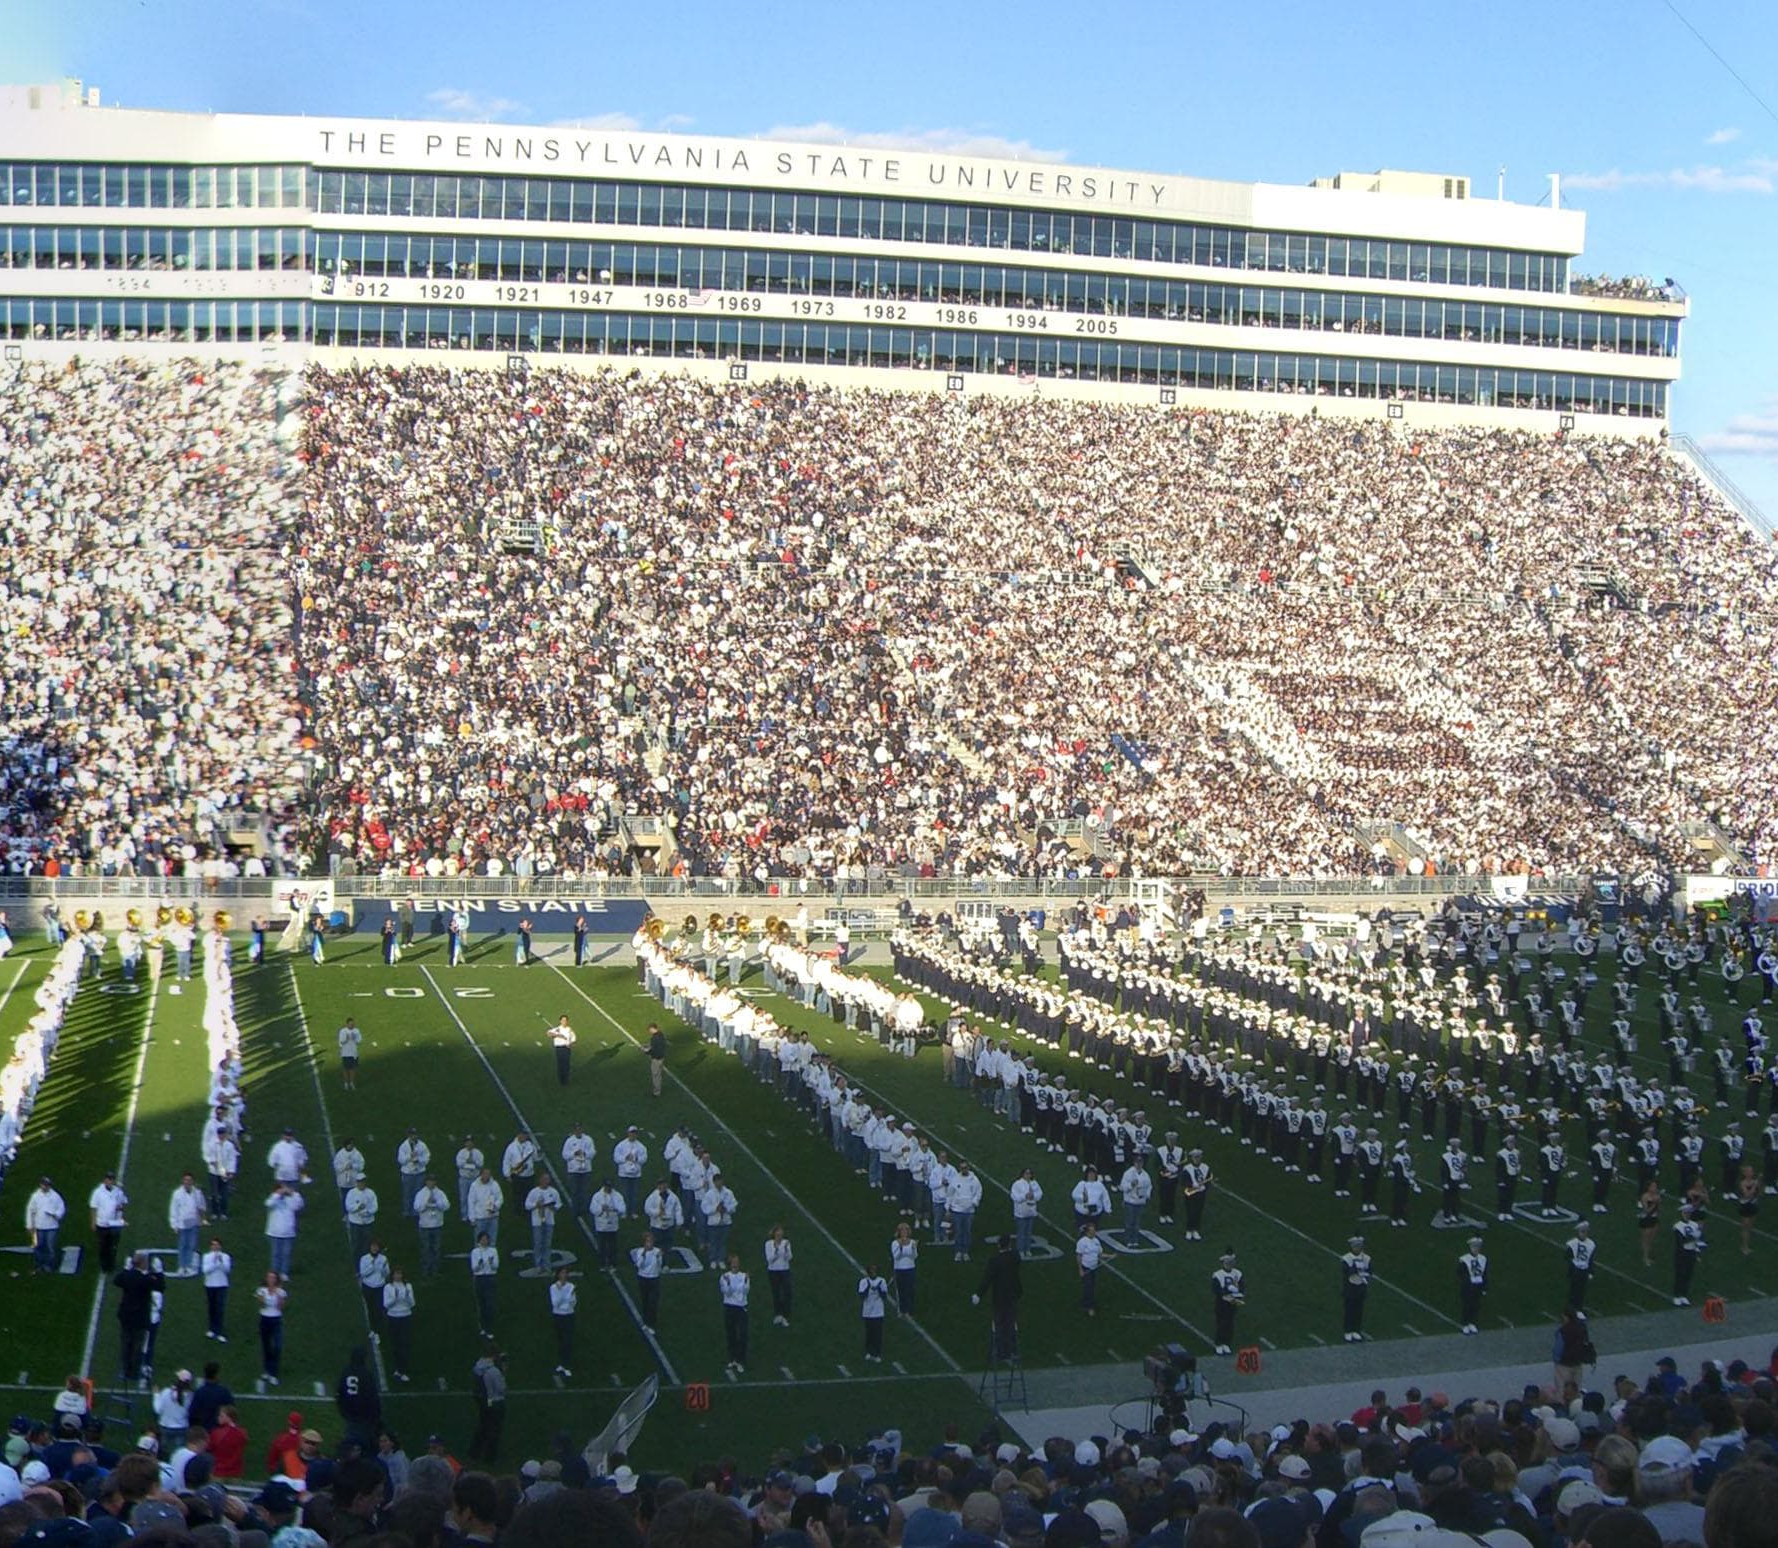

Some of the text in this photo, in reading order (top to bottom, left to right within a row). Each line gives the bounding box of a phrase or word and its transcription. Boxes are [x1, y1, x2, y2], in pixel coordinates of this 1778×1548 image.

[320, 131, 1166, 205] THE PENNSYLVANIA STATE UNIVERSITY
[419, 284, 465, 300] 1920
[496, 287, 540, 302] 1921
[569, 290, 613, 305] 1947
[644, 293, 688, 308] 1968
[718, 296, 762, 312] 1969
[791, 300, 835, 316] 1973
[864, 305, 907, 321] 1982
[935, 309, 978, 325] 1986
[1006, 313, 1048, 330] 1994
[1076, 318, 1118, 335] 2005
[498, 899, 609, 912] STATE
[1238, 1351, 1259, 1374] 30
[688, 1386, 706, 1409] 20
